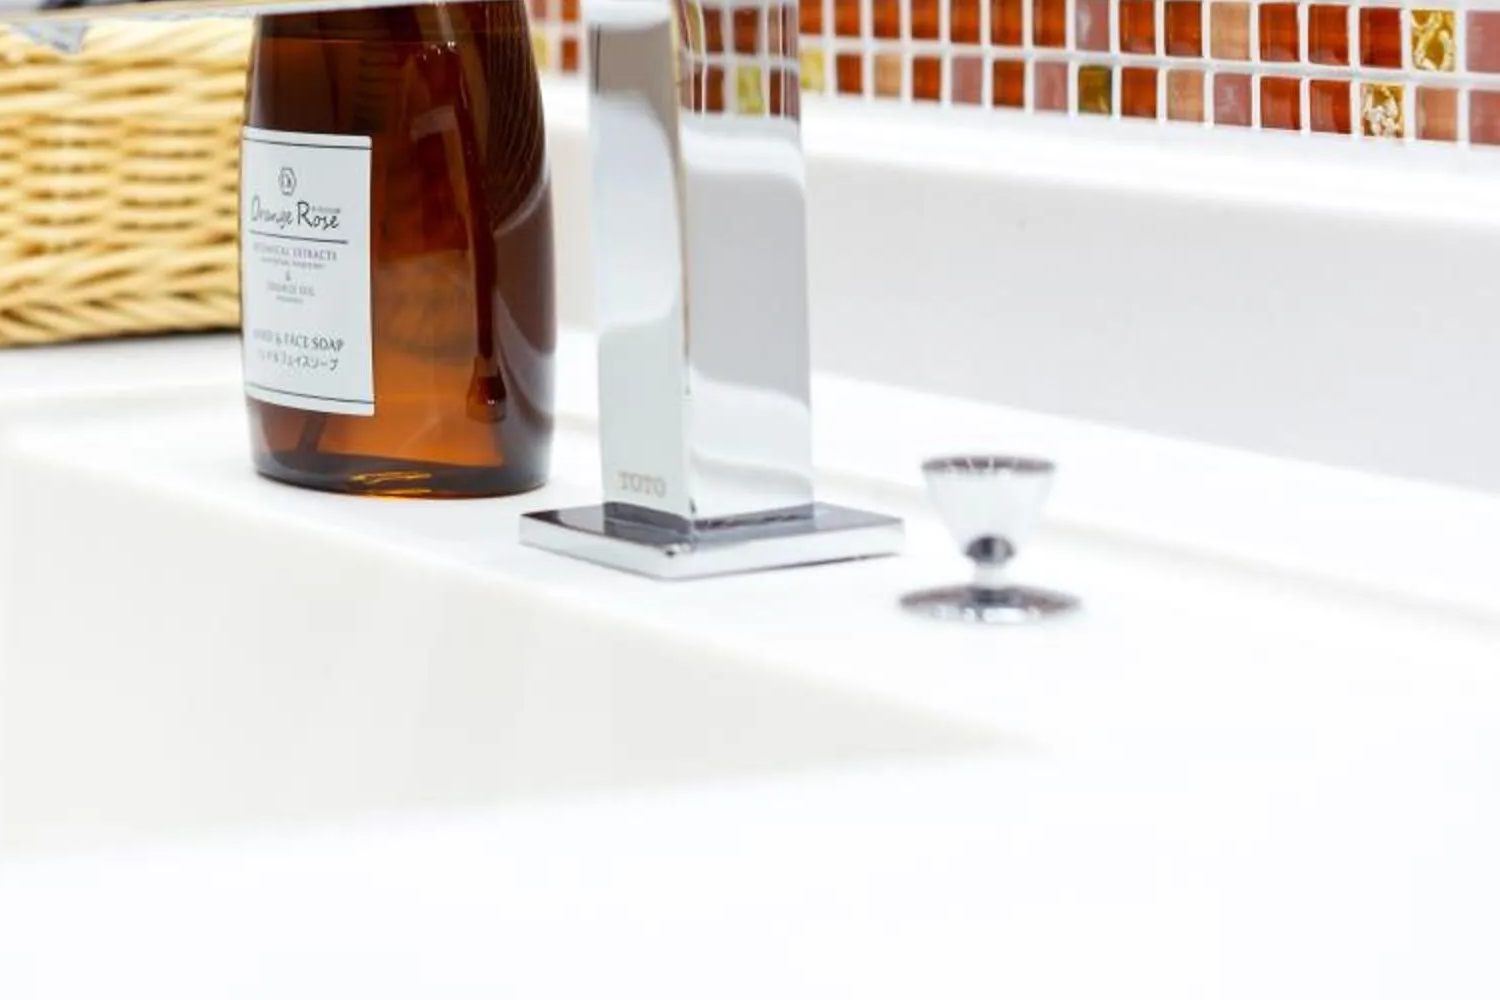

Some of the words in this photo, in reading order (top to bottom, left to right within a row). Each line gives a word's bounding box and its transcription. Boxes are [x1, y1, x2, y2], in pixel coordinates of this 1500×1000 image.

[251, 193, 294, 230] Orange
[297, 200, 340, 230] Rose
[283, 332, 309, 349] FACE
[311, 336, 345, 352] SOAP
[618, 470, 667, 499] TOTO
